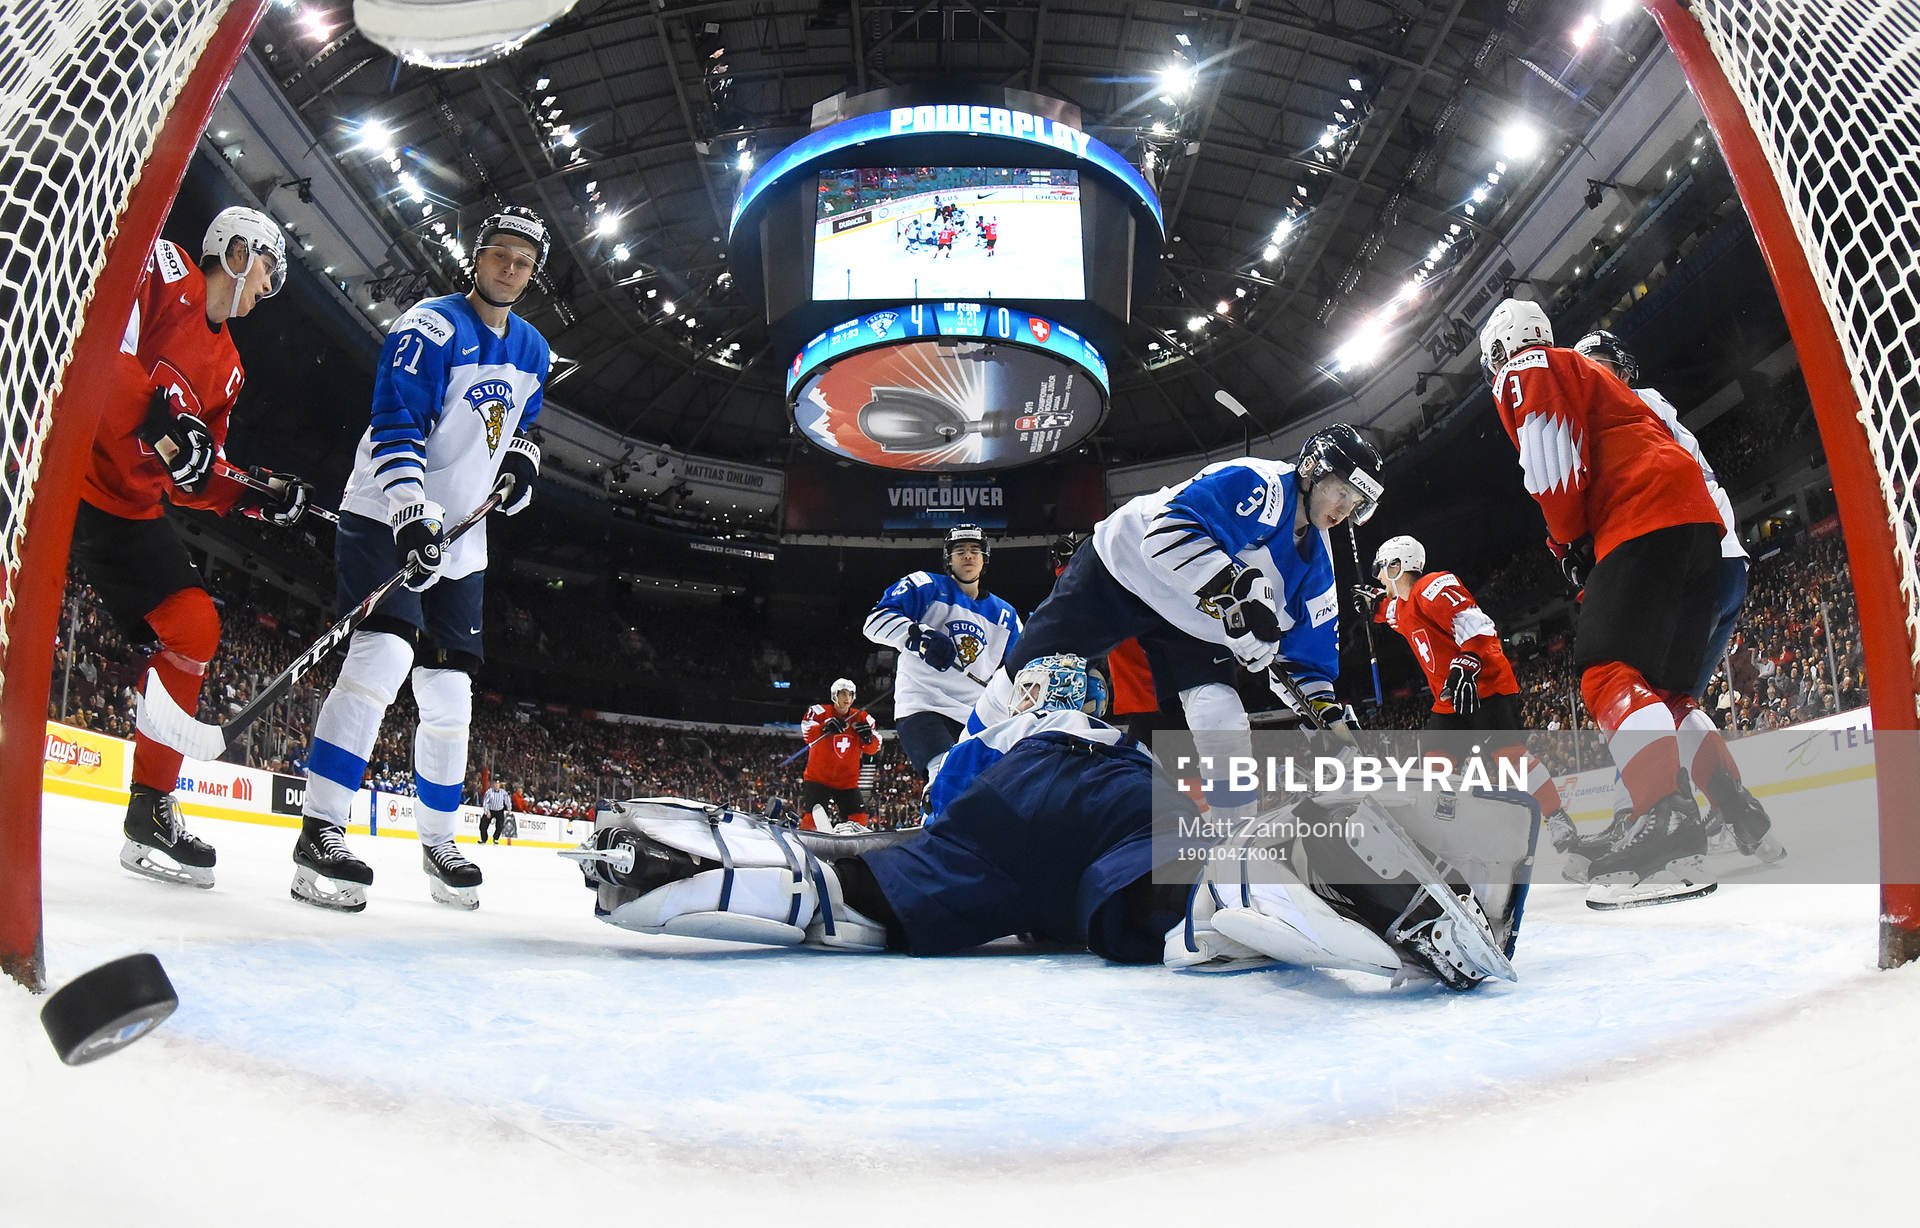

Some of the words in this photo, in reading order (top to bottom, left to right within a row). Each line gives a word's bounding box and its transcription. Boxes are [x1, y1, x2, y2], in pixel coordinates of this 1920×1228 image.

[890, 105, 1091, 158] POWERPLAY
[911, 304, 923, 335] 4
[956, 310, 978, 327] 3:21
[998, 307, 1010, 339] 0
[1535, 327, 1541, 338] 9
[392, 334, 424, 375] 21
[225, 366, 241, 398] C
[234, 472, 249, 483] CCM
[684, 463, 725, 481] MATTIAS
[888, 487, 1004, 507] VANCOUVER
[1236, 484, 1266, 517] 3
[1441, 587, 1467, 607] 11
[1000, 608, 1010, 628] C
[291, 618, 351, 686] CCM
[198, 780, 228, 798] MART
[1575, 784, 1615, 797] CAMPBELL
[400, 807, 412, 817] AIR
[527, 821, 546, 832] TISSOT
